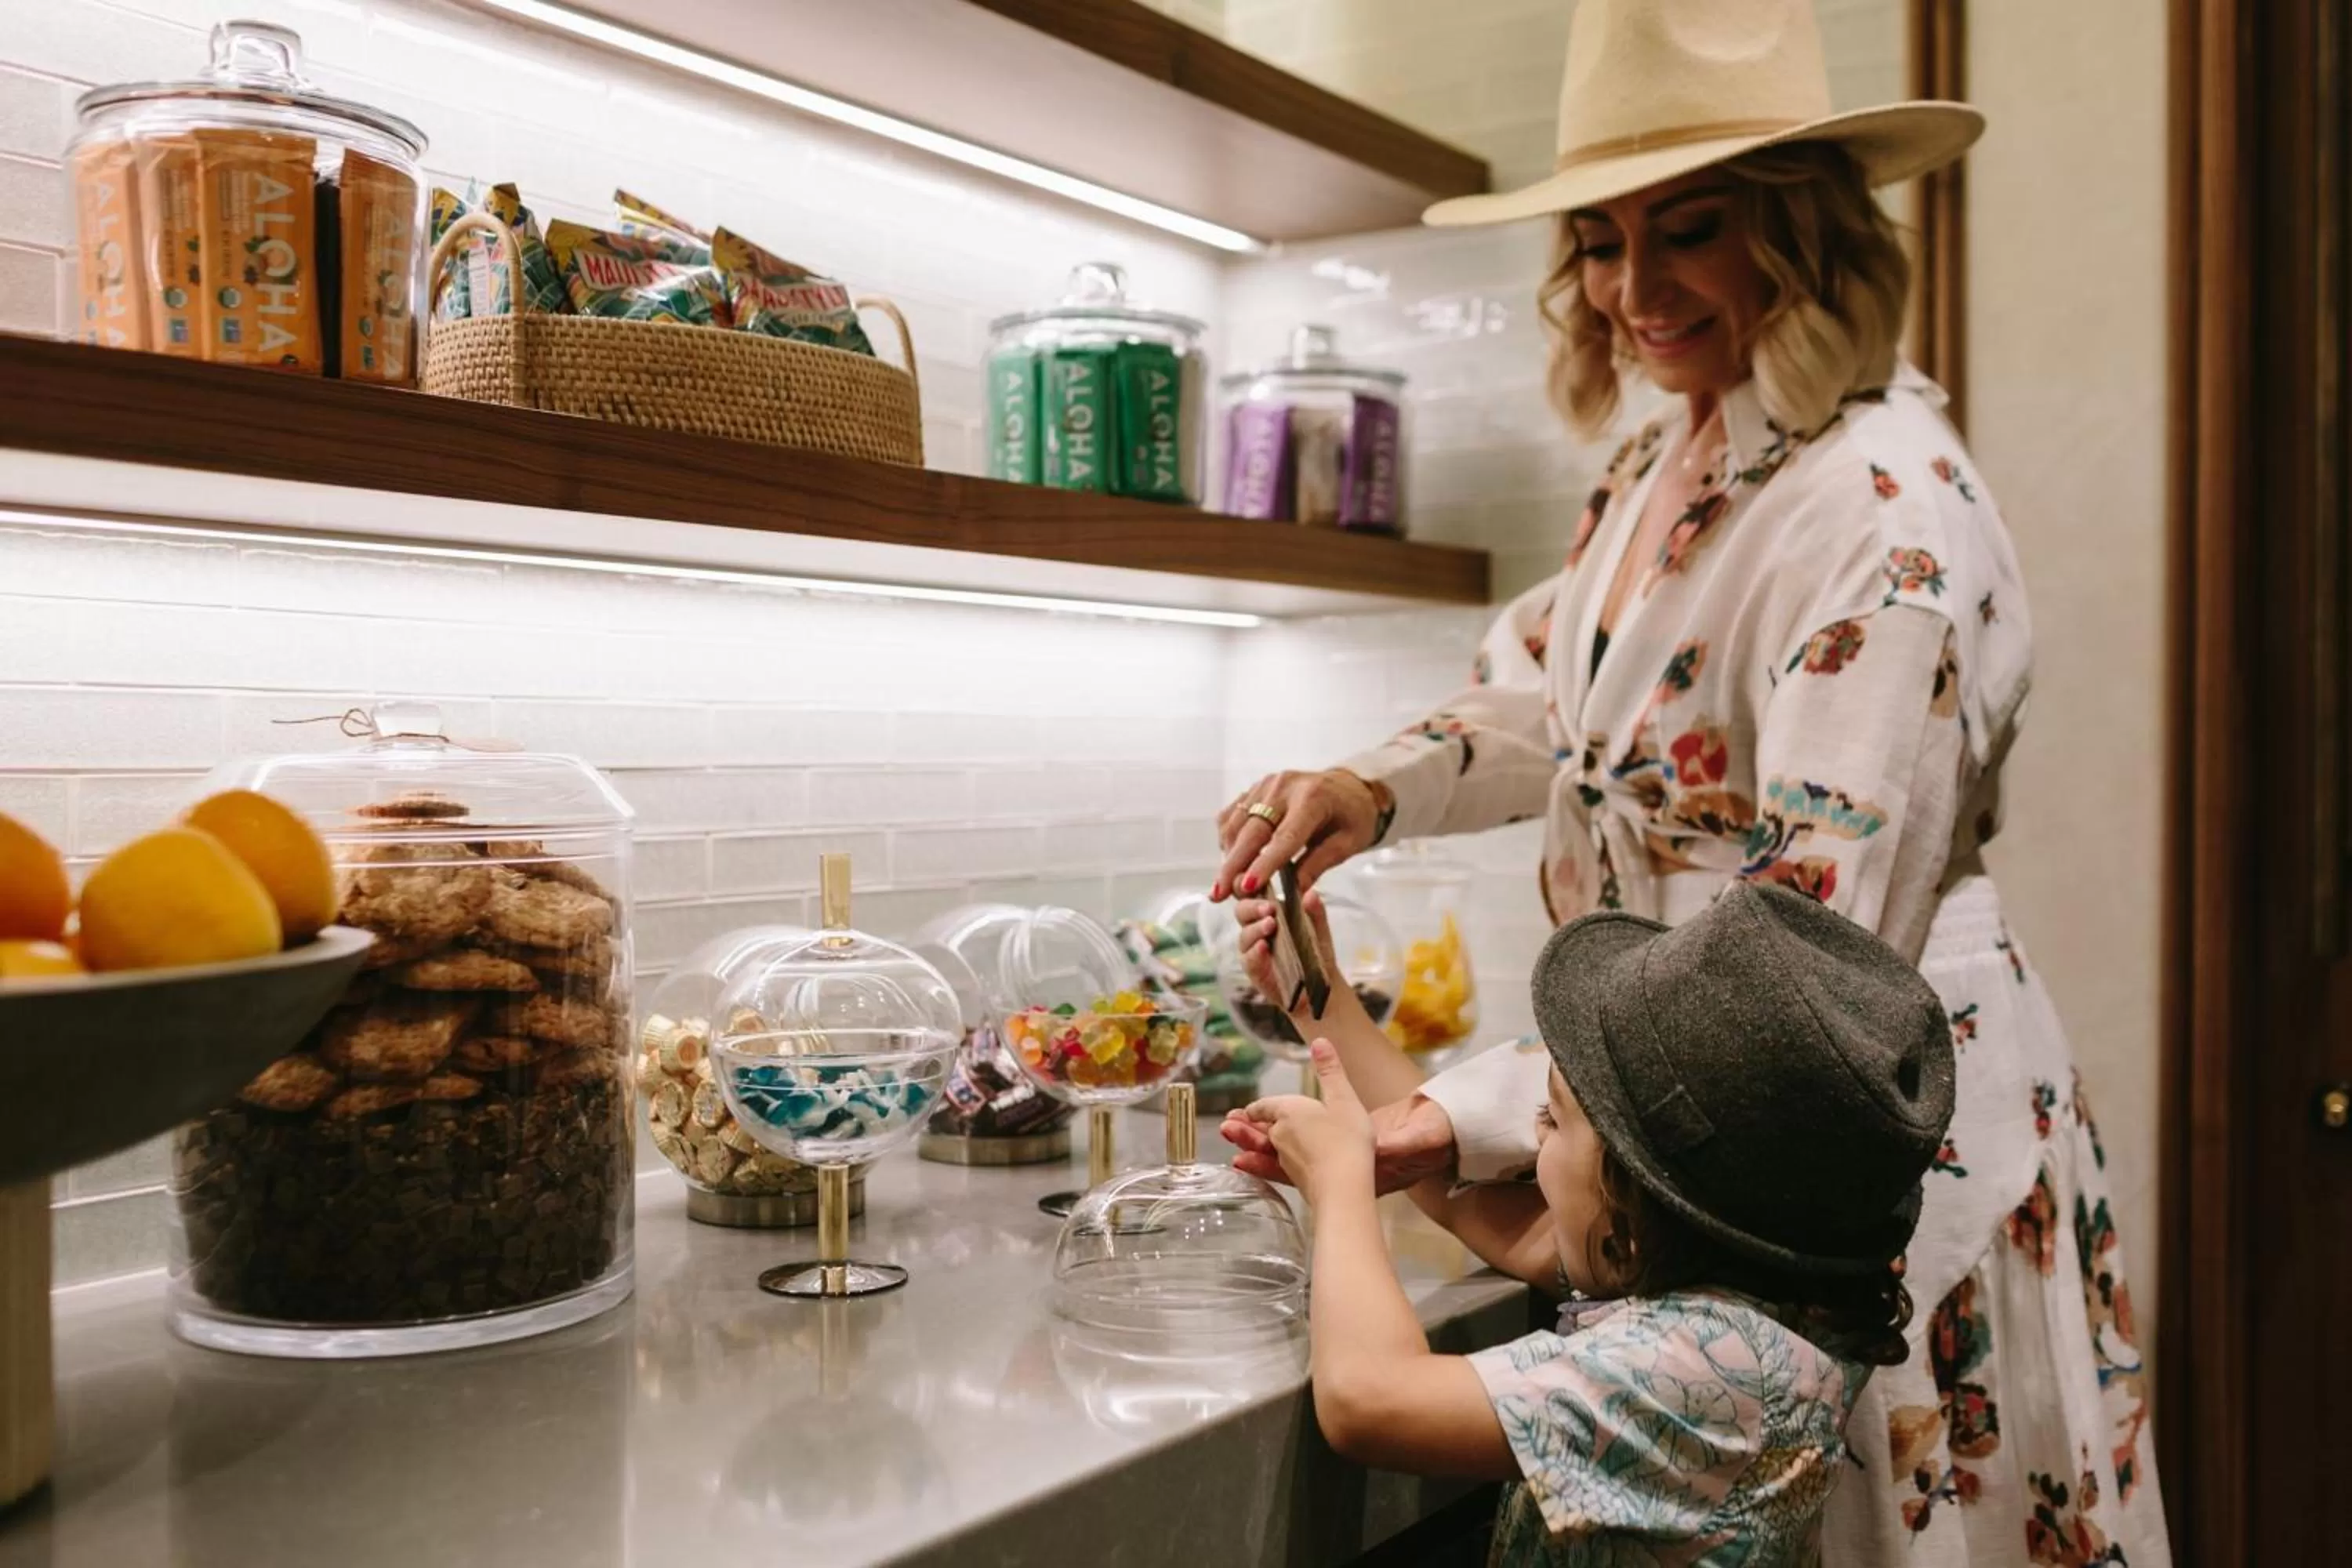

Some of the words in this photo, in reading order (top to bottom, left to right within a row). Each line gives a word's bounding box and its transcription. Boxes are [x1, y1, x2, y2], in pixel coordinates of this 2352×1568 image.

[252, 172, 298, 353] ALOHA
[1004, 371, 1024, 483] ALOHA
[1065, 361, 1094, 482] ALOHA
[1150, 369, 1174, 489] ALOHA
